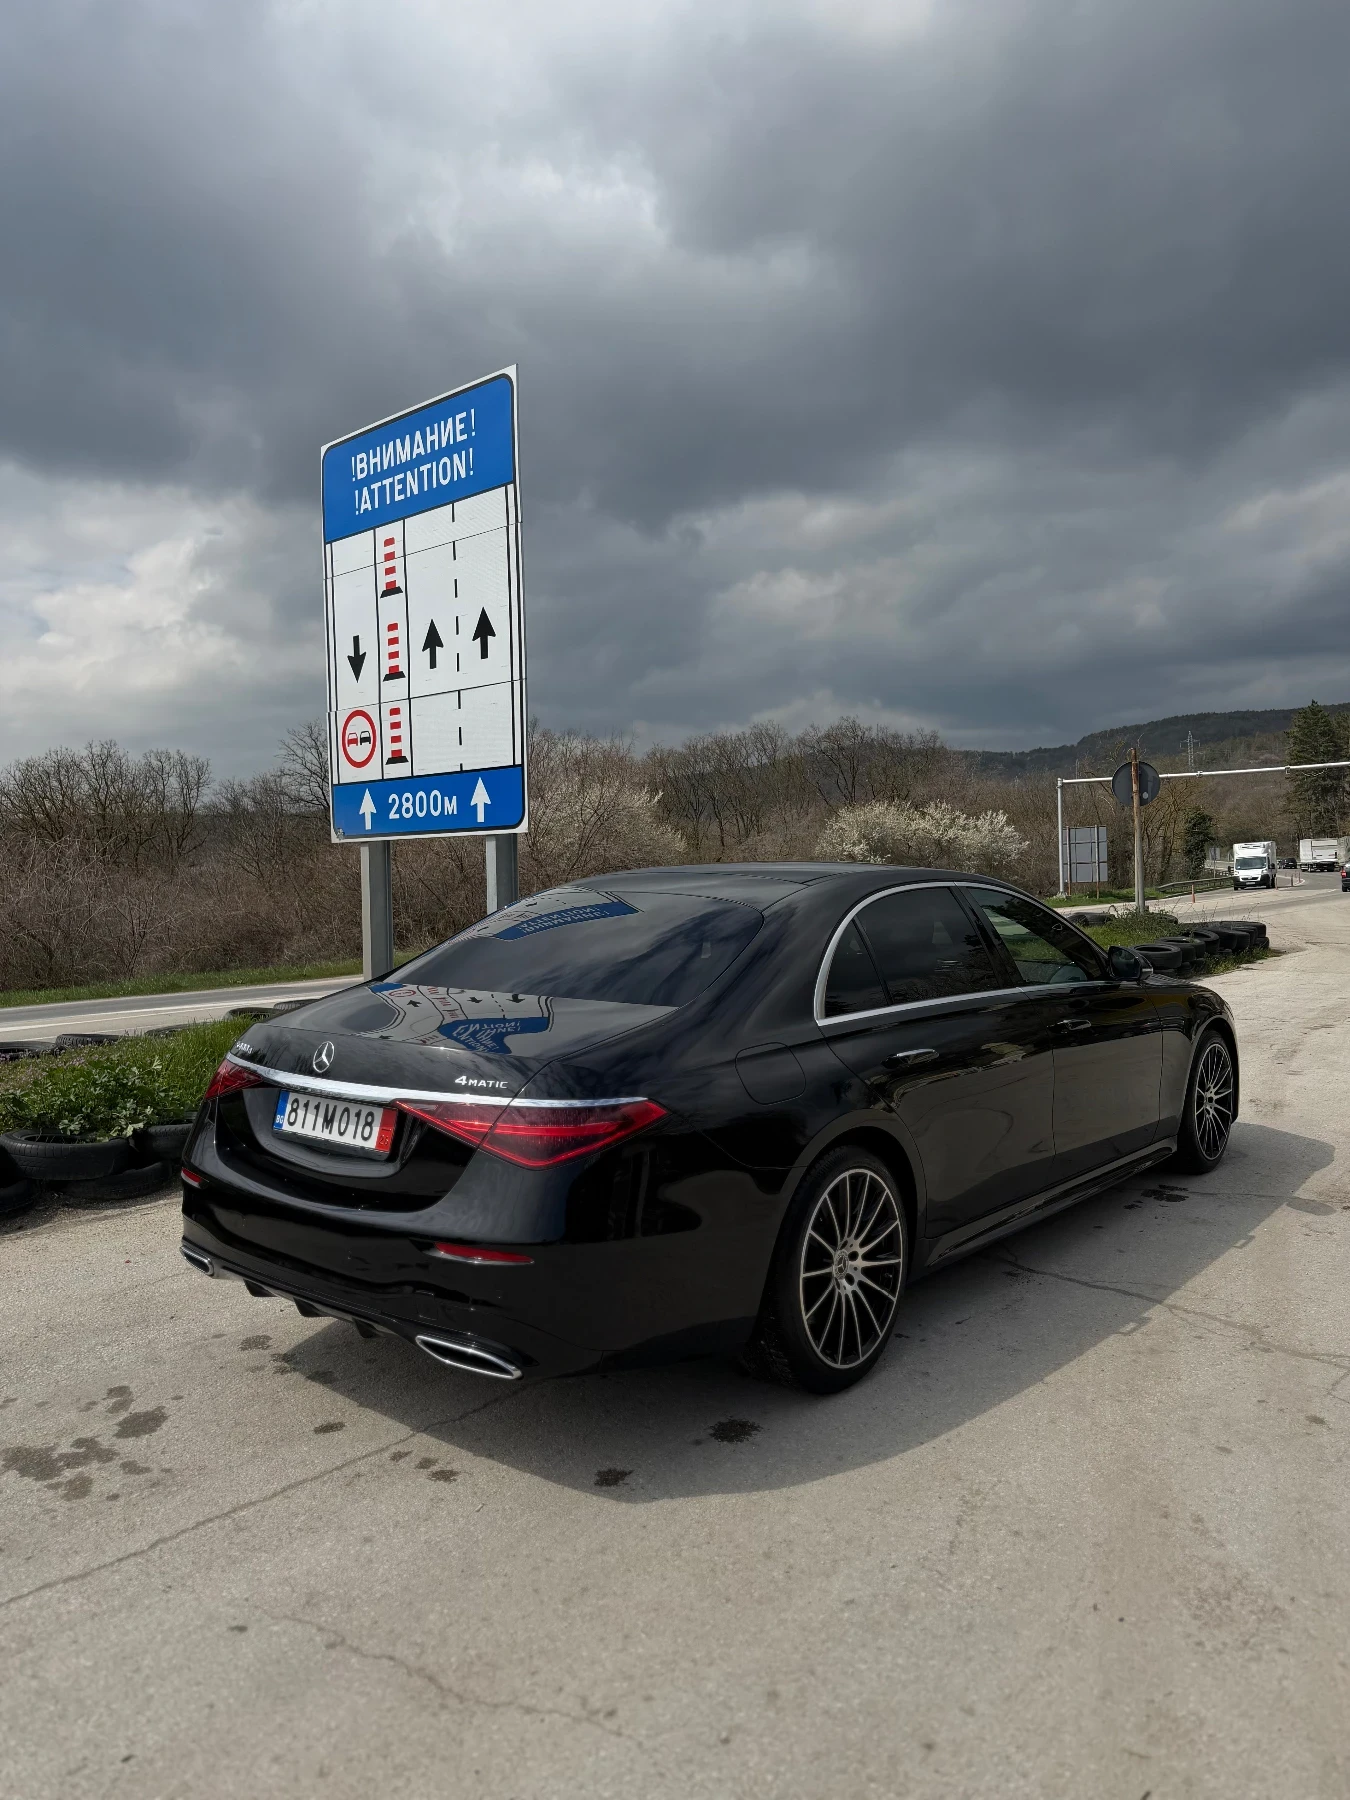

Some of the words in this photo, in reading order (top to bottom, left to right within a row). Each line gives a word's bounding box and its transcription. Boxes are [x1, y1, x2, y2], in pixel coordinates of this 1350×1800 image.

[351, 408, 476, 482] !ВНИМАНИЕ!
[354, 447, 474, 516] !ATTENTION!
[454, 1075, 509, 1089] 4MATIC
[287, 1097, 375, 1142] 811M018
